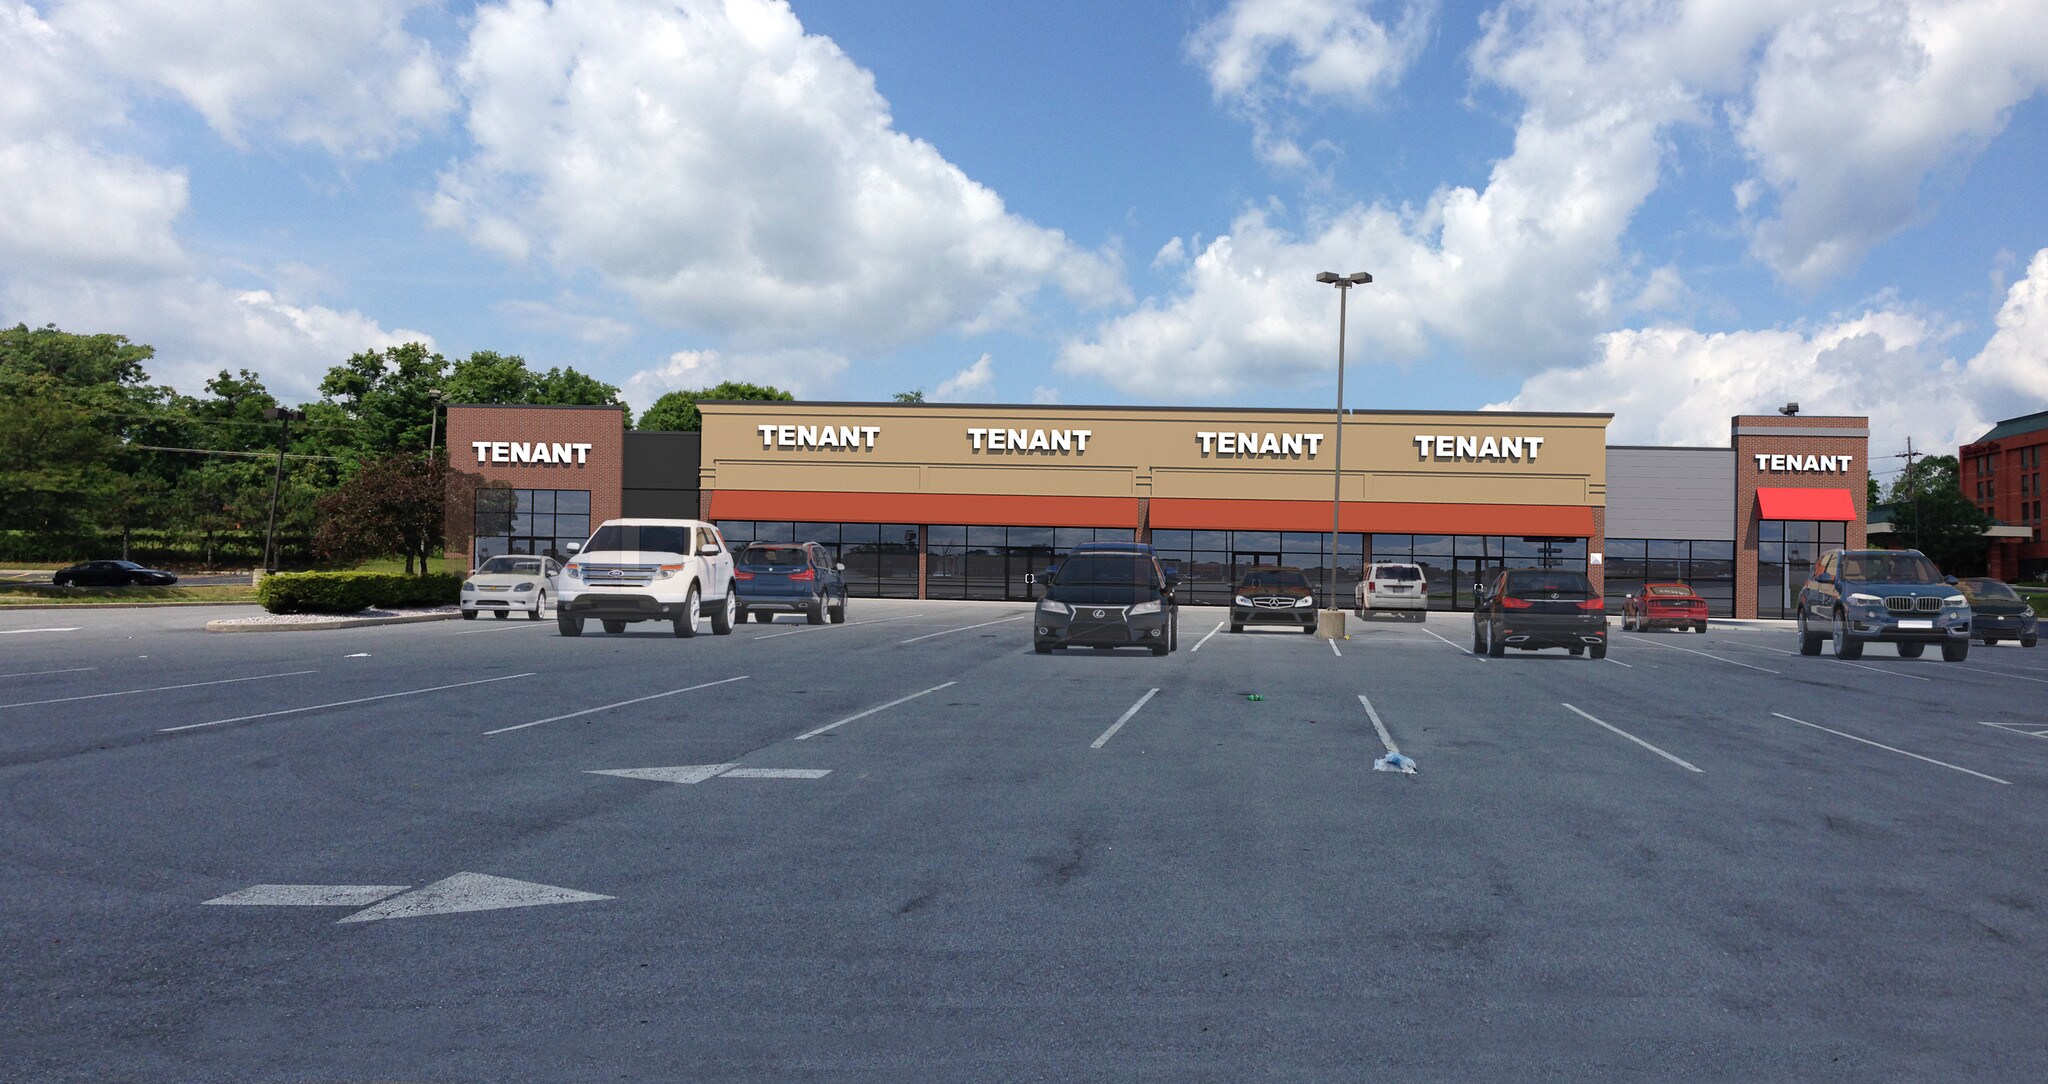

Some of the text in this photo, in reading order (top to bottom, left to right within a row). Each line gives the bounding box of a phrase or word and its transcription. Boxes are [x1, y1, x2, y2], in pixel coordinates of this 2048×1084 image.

[758, 425, 881, 447] TENANT
[968, 429, 1092, 451] TENANT
[1197, 432, 1324, 455] TENANT
[1414, 436, 1544, 458] TENANT
[472, 442, 592, 464] TENANT
[1755, 454, 1853, 472] TENANT
